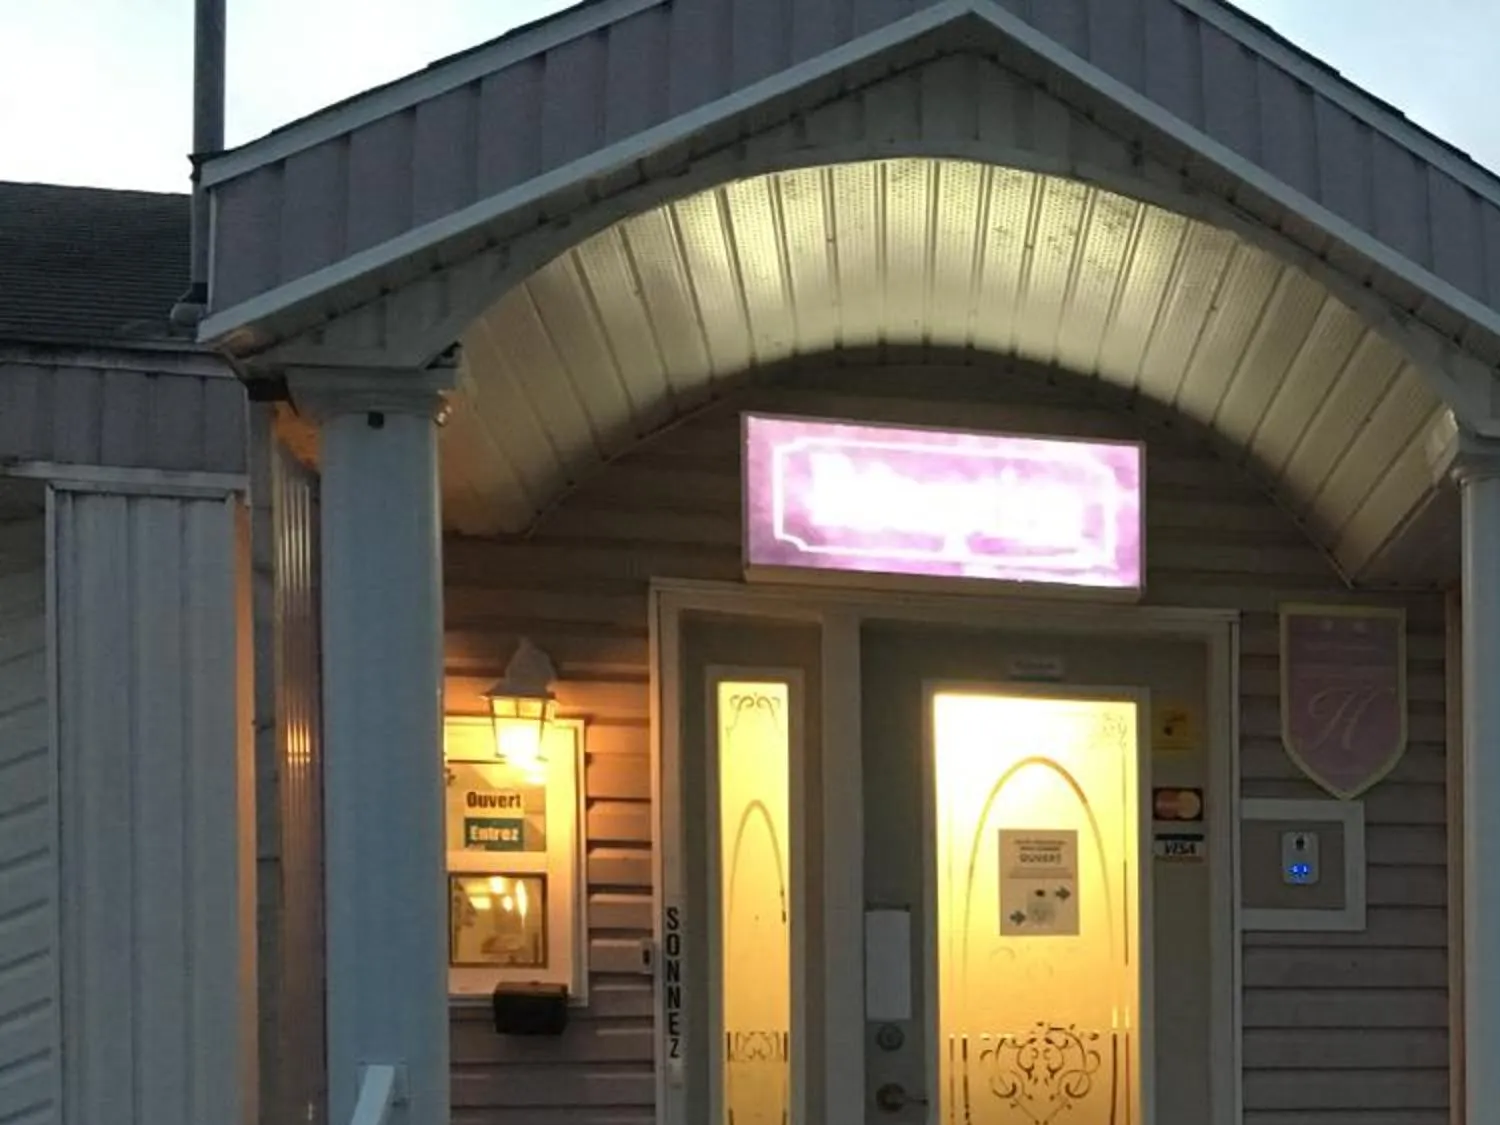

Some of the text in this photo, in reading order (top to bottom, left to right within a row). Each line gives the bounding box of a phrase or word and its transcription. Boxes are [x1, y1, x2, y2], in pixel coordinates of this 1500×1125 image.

[466, 791, 521, 808] Ouvert
[469, 826, 519, 841] Entrez
[1164, 842, 1197, 855] VISA
[666, 906, 681, 1059] SONNEZ
